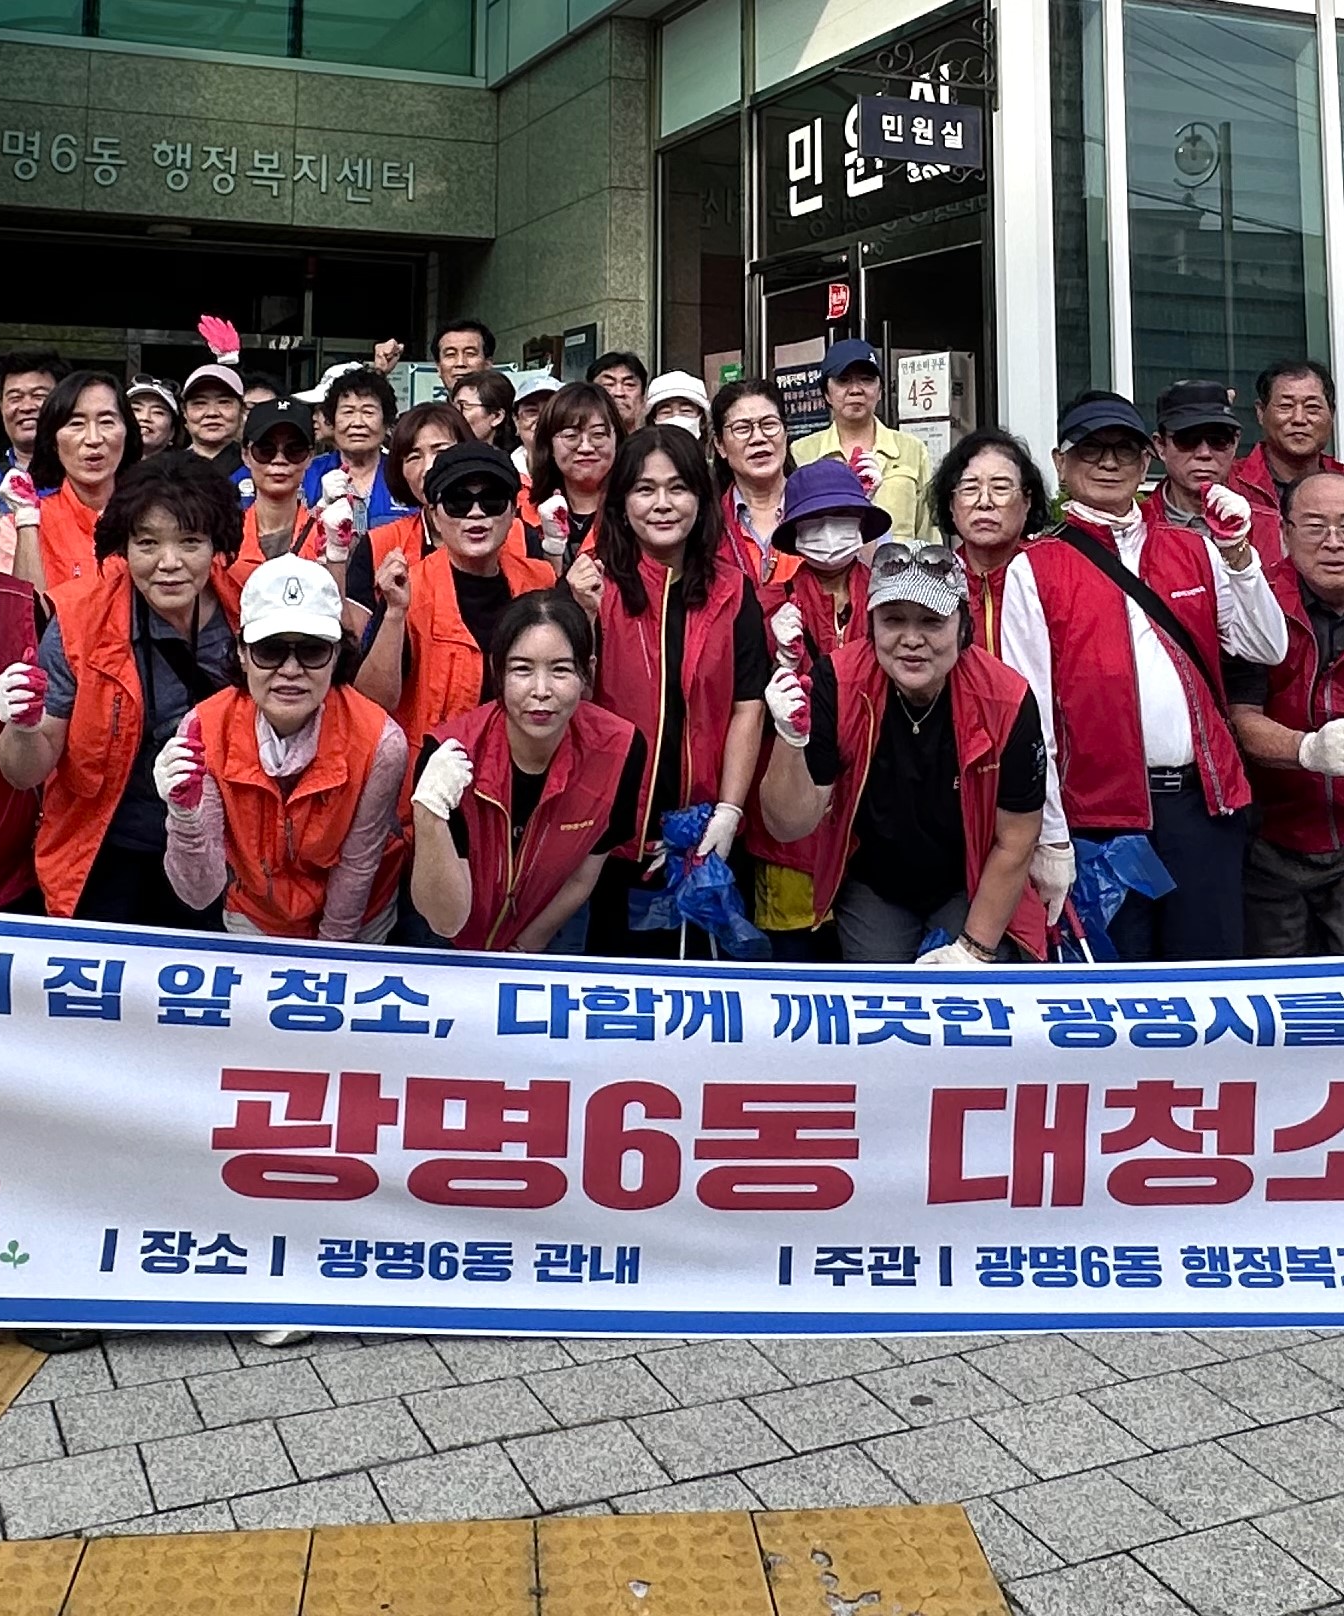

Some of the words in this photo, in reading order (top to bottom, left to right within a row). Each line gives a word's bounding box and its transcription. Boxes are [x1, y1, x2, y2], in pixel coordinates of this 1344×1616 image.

[881, 113, 964, 150] 민원실
[151, 138, 415, 204] 행정복지센터
[908, 376, 939, 412] 4층
[43, 956, 127, 1021] 집
[157, 964, 242, 1028] 앞
[266, 968, 455, 1039] 청소,
[496, 982, 744, 1043] 다함께
[770, 992, 1015, 1047] 깨끗한
[212, 1068, 860, 1211] 광명6동
[139, 1230, 248, 1276] 장소
[318, 1239, 514, 1283] 광명6동
[533, 1243, 641, 1284] 관내
[813, 1246, 921, 1287] 주관
[975, 1245, 1164, 1289] 광명6동
